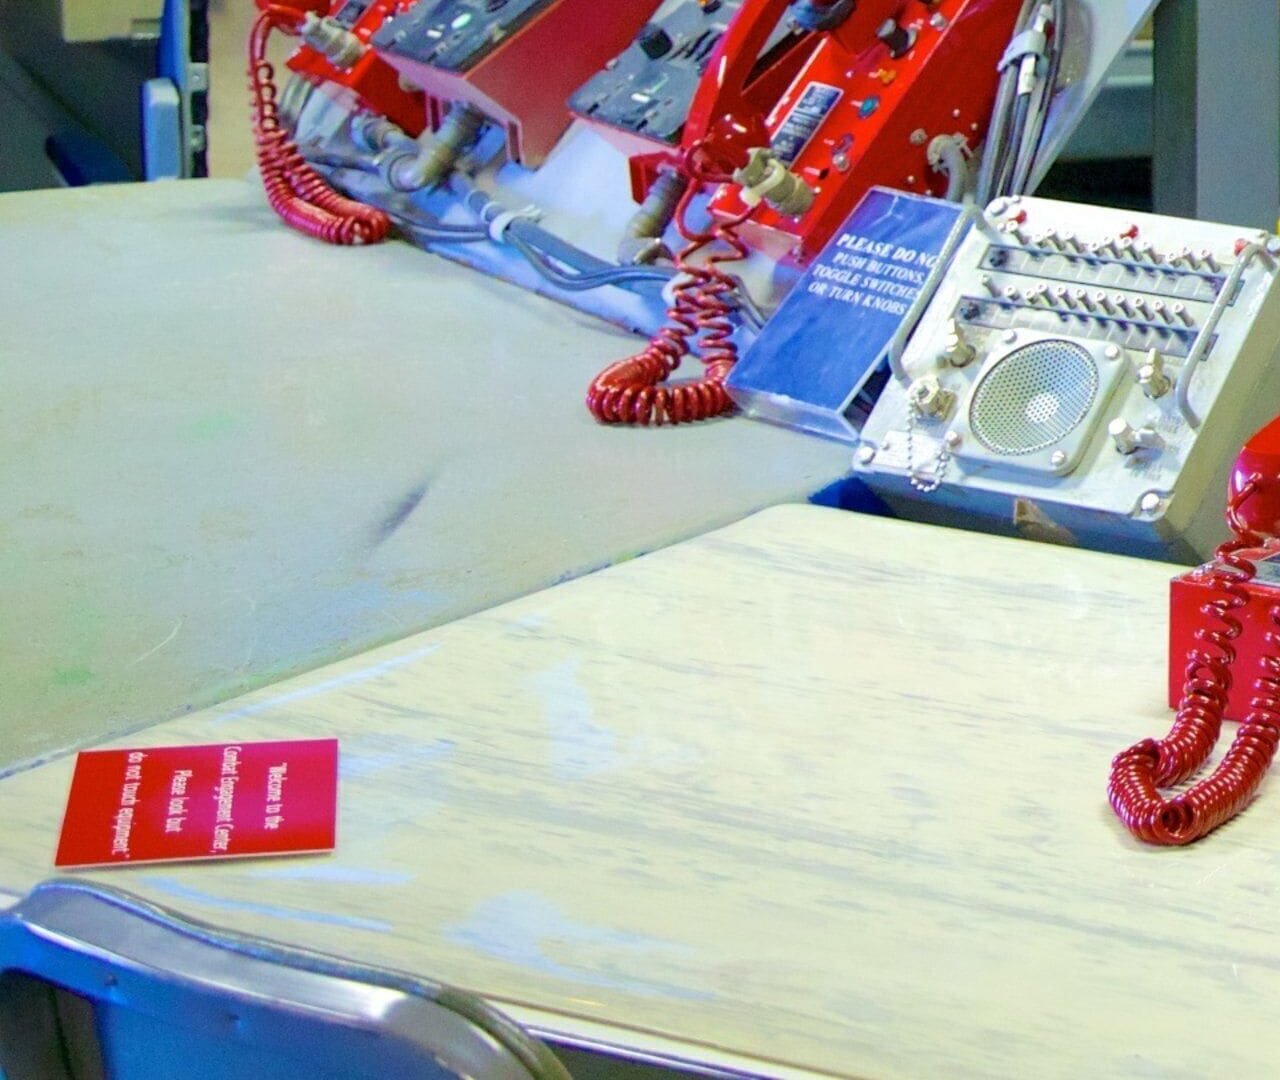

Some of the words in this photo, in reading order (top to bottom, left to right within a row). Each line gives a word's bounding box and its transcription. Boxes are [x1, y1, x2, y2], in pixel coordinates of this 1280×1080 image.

[837, 233, 894, 257] PLEASE
[895, 246, 916, 263] DO
[919, 252, 940, 269] NO
[812, 264, 861, 288] TOGGLE
[832, 251, 866, 270] PUSH
[868, 259, 925, 285] BUTTONS,
[807, 281, 826, 295] OR
[830, 286, 862, 307] TURN
[863, 294, 908, 315] KNOBS
[128, 751, 149, 764] do
[221, 745, 243, 775] Combat
[125, 765, 143, 780] not
[170, 769, 193, 796] Please
[120, 782, 141, 806] touch
[168, 796, 190, 815] look
[213, 776, 239, 822] Engagement
[165, 817, 183, 833] but
[264, 816, 286, 830] the
